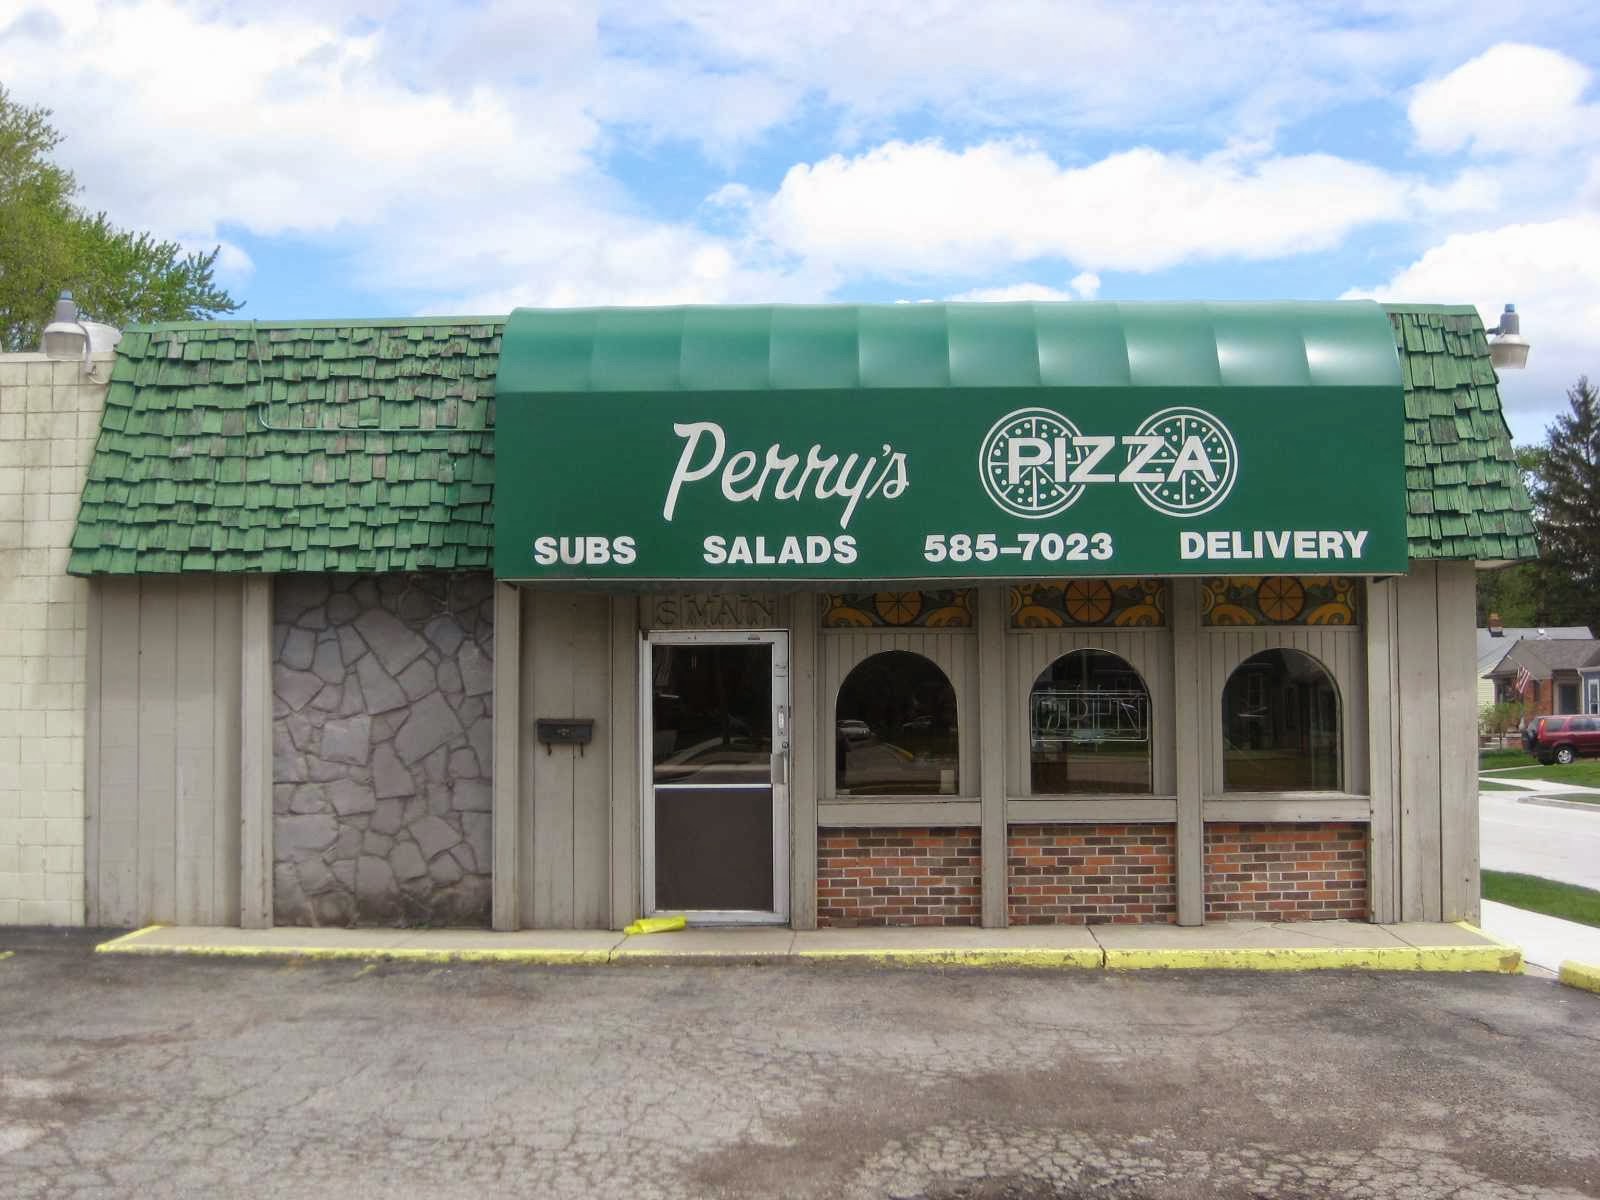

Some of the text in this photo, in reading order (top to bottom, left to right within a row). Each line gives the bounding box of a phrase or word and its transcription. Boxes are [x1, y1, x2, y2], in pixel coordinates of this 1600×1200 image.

[663, 421, 1217, 530] Perry's PIZZA
[534, 530, 1369, 565] SUBS SALADS 585-7023 DELIVERY
